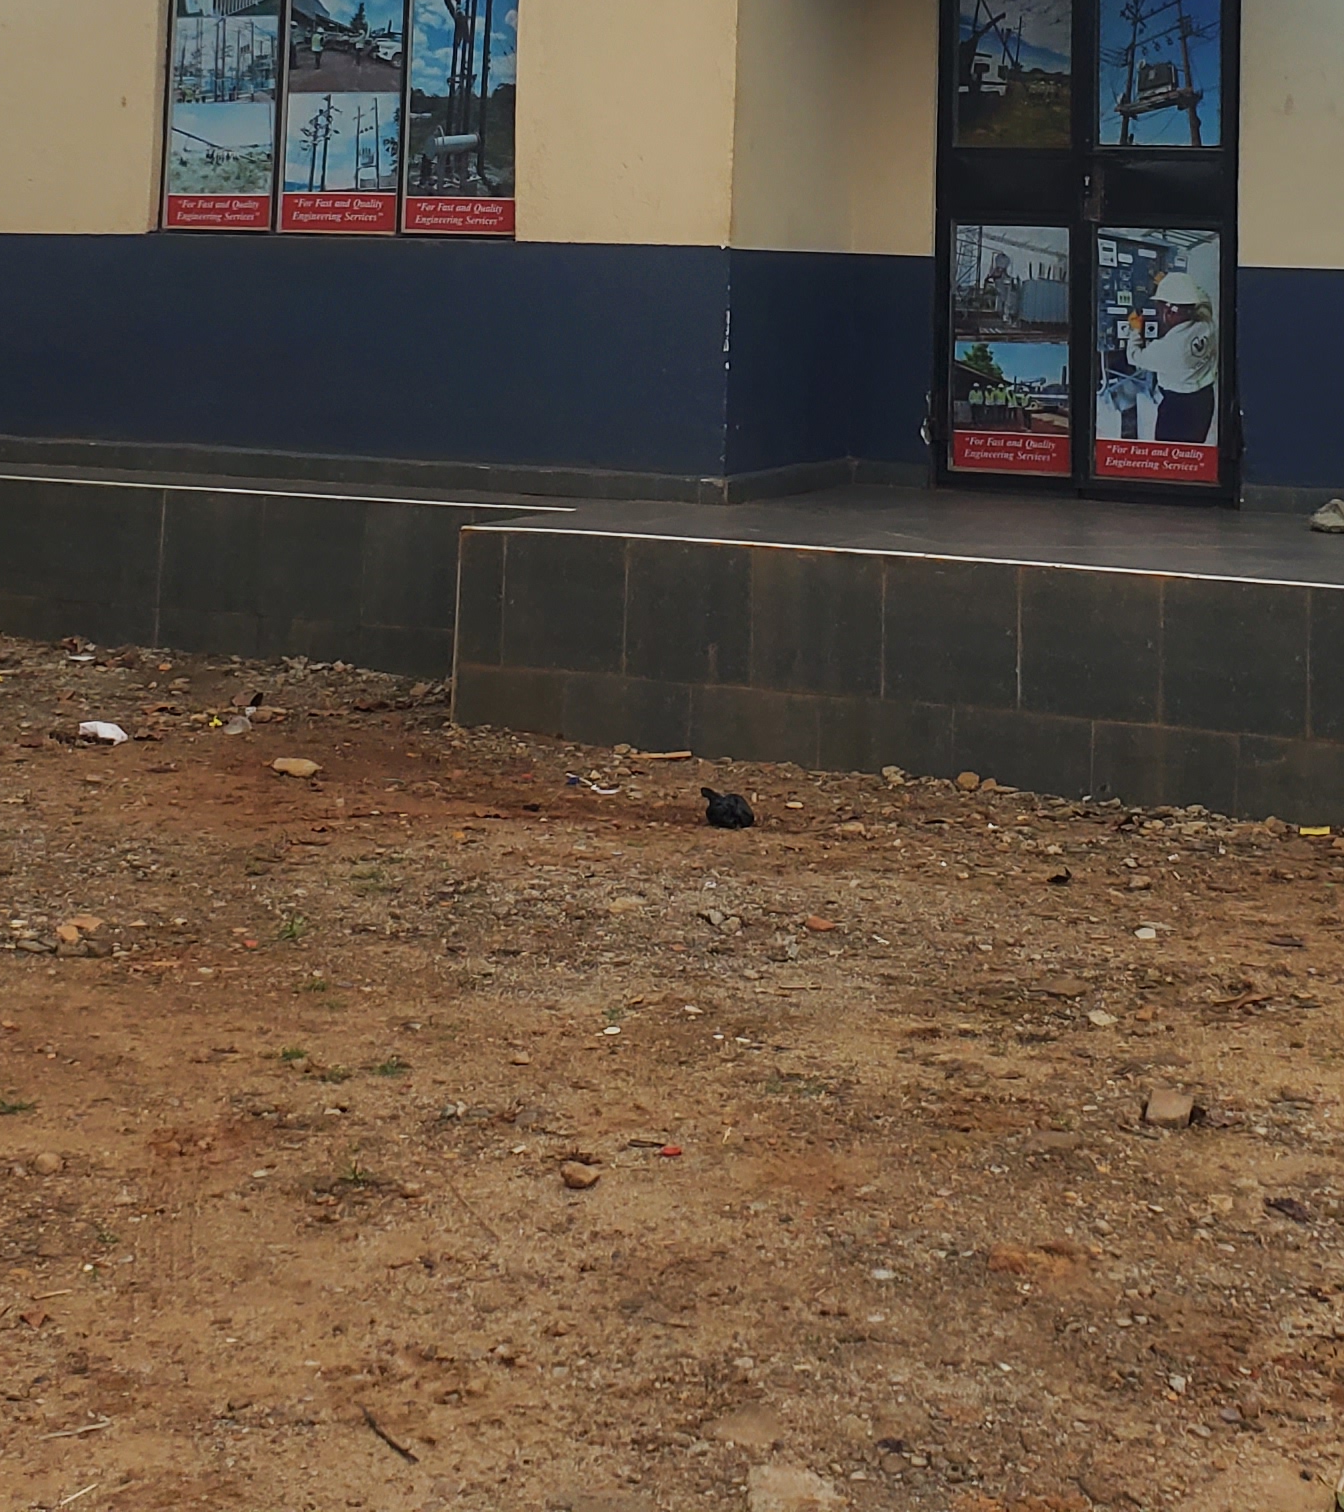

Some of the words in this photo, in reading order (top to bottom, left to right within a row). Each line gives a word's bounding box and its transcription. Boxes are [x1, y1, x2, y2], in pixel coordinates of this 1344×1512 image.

[987, 437, 1004, 446] Fast
[1007, 439, 1022, 447] and
[1026, 439, 1055, 450] Quality
[964, 449, 1014, 461] Engineering
[1131, 446, 1149, 455] Fast
[1151, 447, 1168, 456] and
[1172, 448, 1204, 460] Quality
[1105, 457, 1159, 470] Engineering
